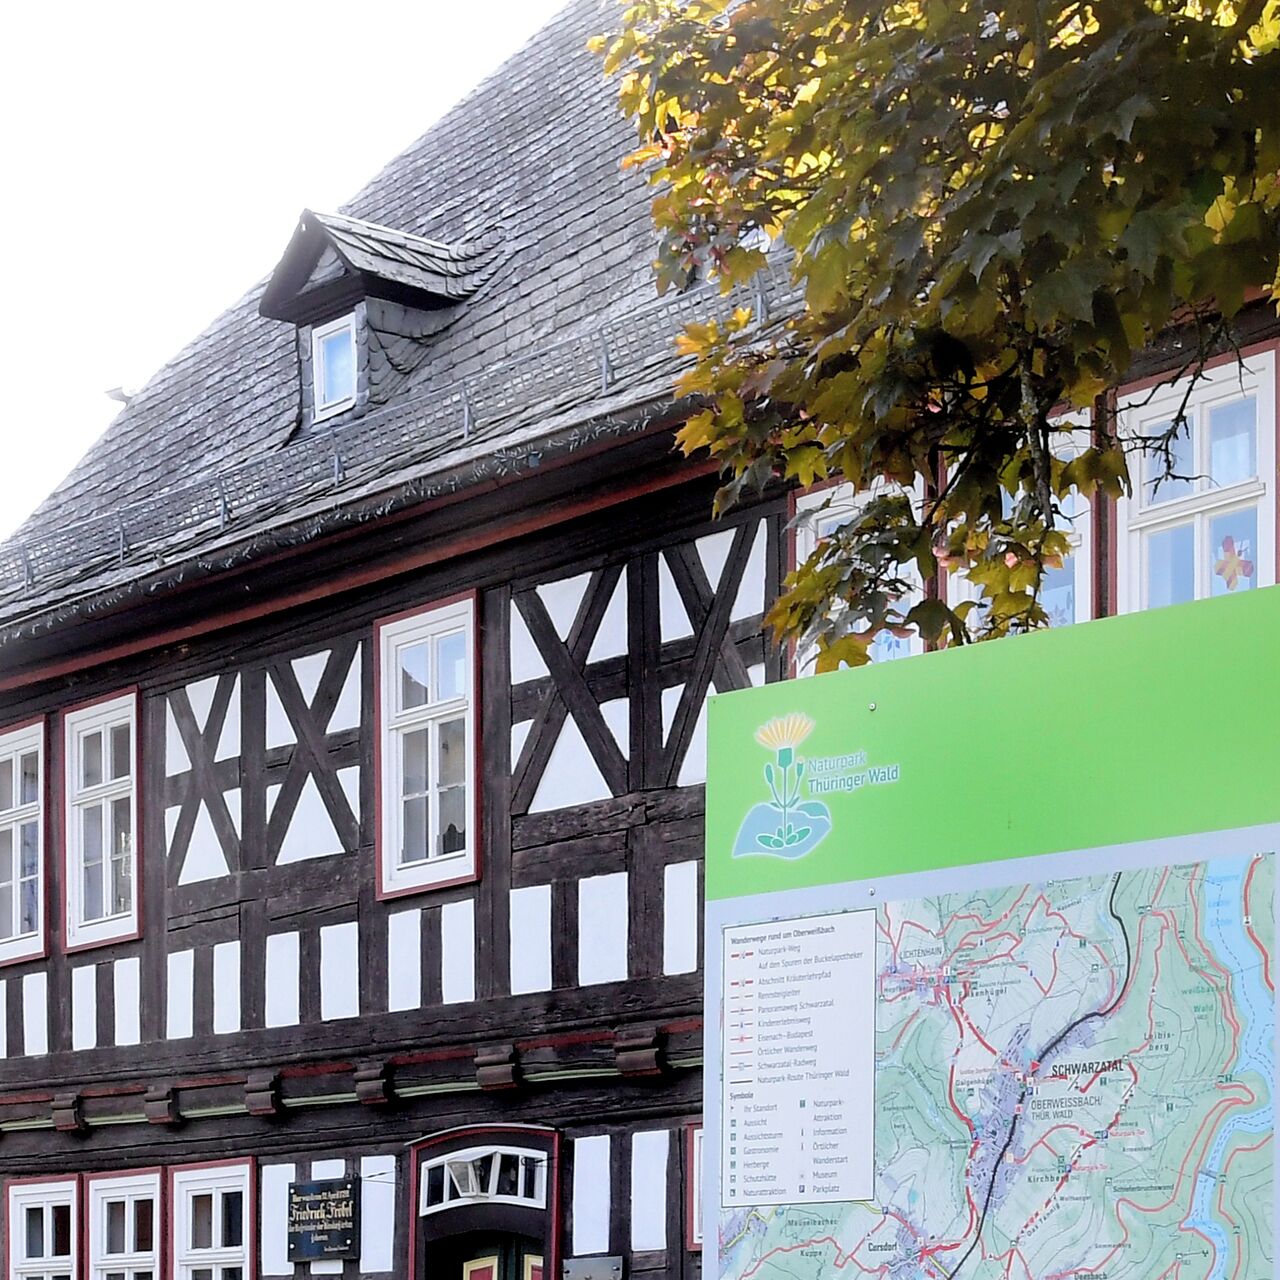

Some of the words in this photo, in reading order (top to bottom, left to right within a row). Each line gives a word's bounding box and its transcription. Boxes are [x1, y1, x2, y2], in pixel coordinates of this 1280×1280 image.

[808, 751, 865, 772] Naturpark
[808, 774, 865, 793] Thüringer
[868, 765, 898, 783] Wald
[899, 946, 942, 960] LICHTENHAIN
[1051, 1059, 1123, 1076] SCHWARZATAL
[1031, 1095, 1102, 1110] OBERWEISSBACH/
[1053, 1109, 1073, 1119] WALD
